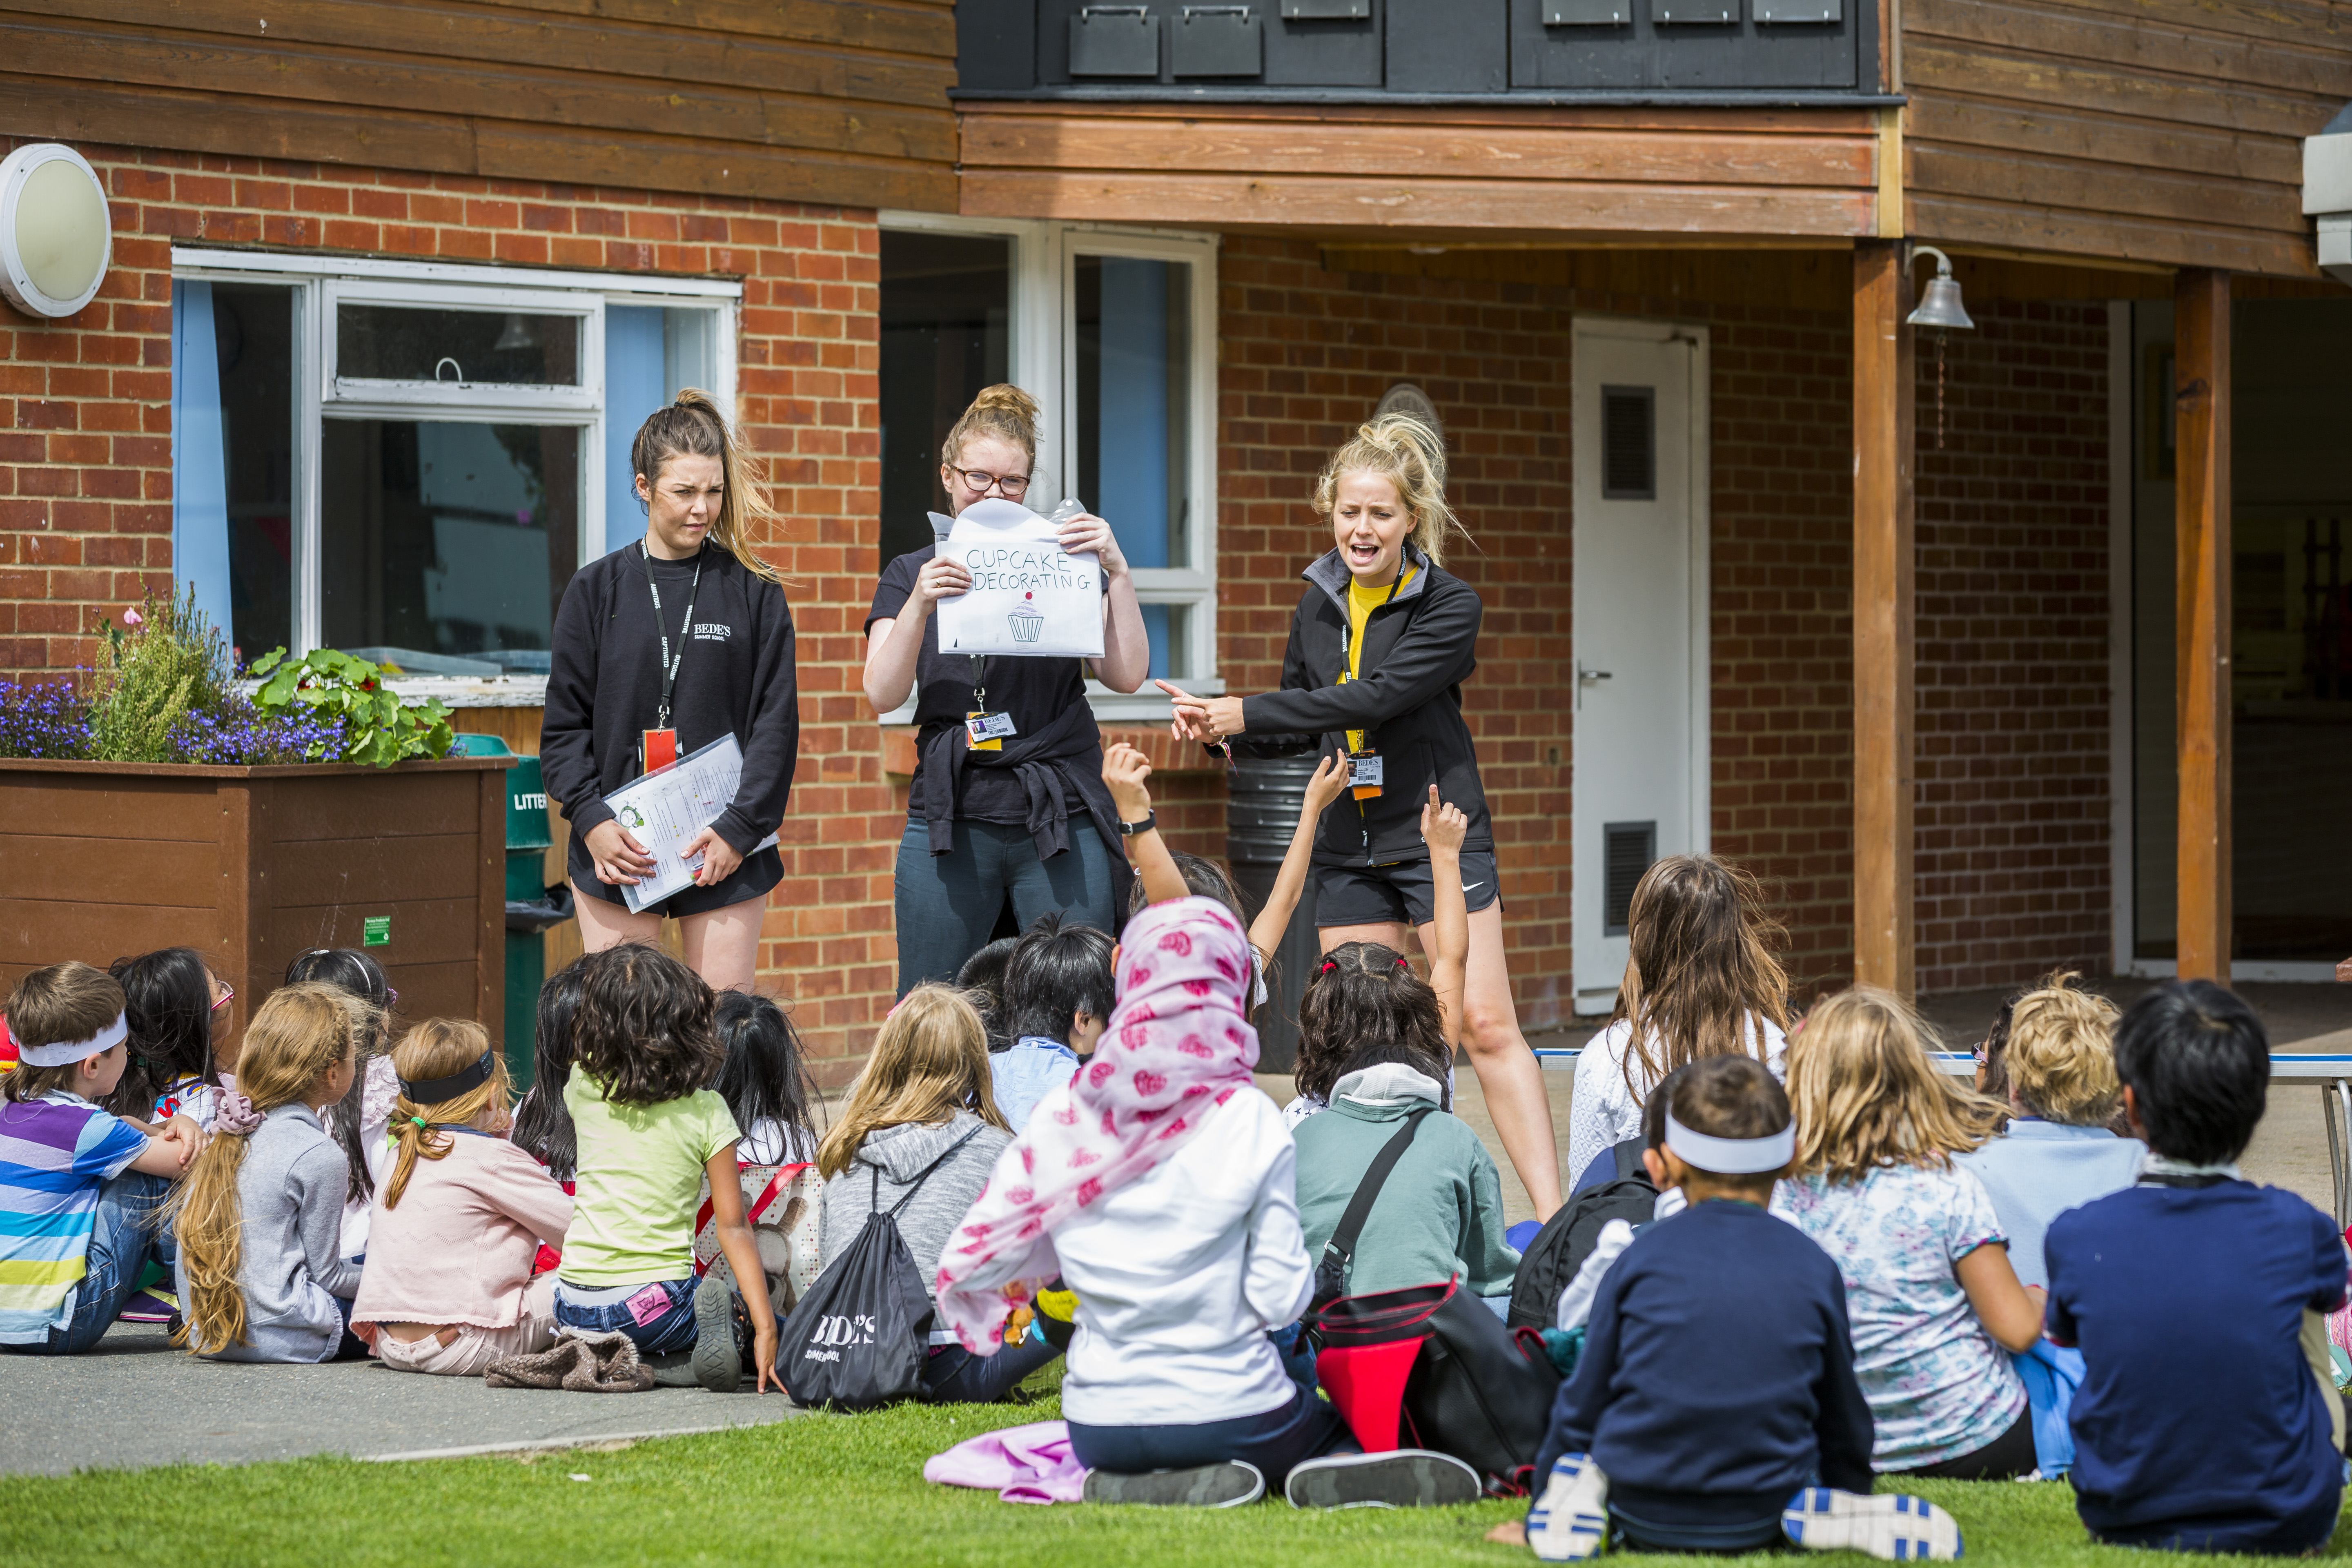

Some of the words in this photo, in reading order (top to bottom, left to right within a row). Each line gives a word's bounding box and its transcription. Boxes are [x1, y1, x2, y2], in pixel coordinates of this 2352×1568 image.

[967, 549, 1071, 572] CUPCAKE
[974, 572, 1091, 590] DECORATING
[650, 583, 661, 609] AMBITIOUS
[682, 605, 693, 634] INQUISITIVE
[694, 624, 731, 637] BEDE'S
[669, 654, 681, 681] OUTGOING
[514, 793, 548, 811] LITTER
